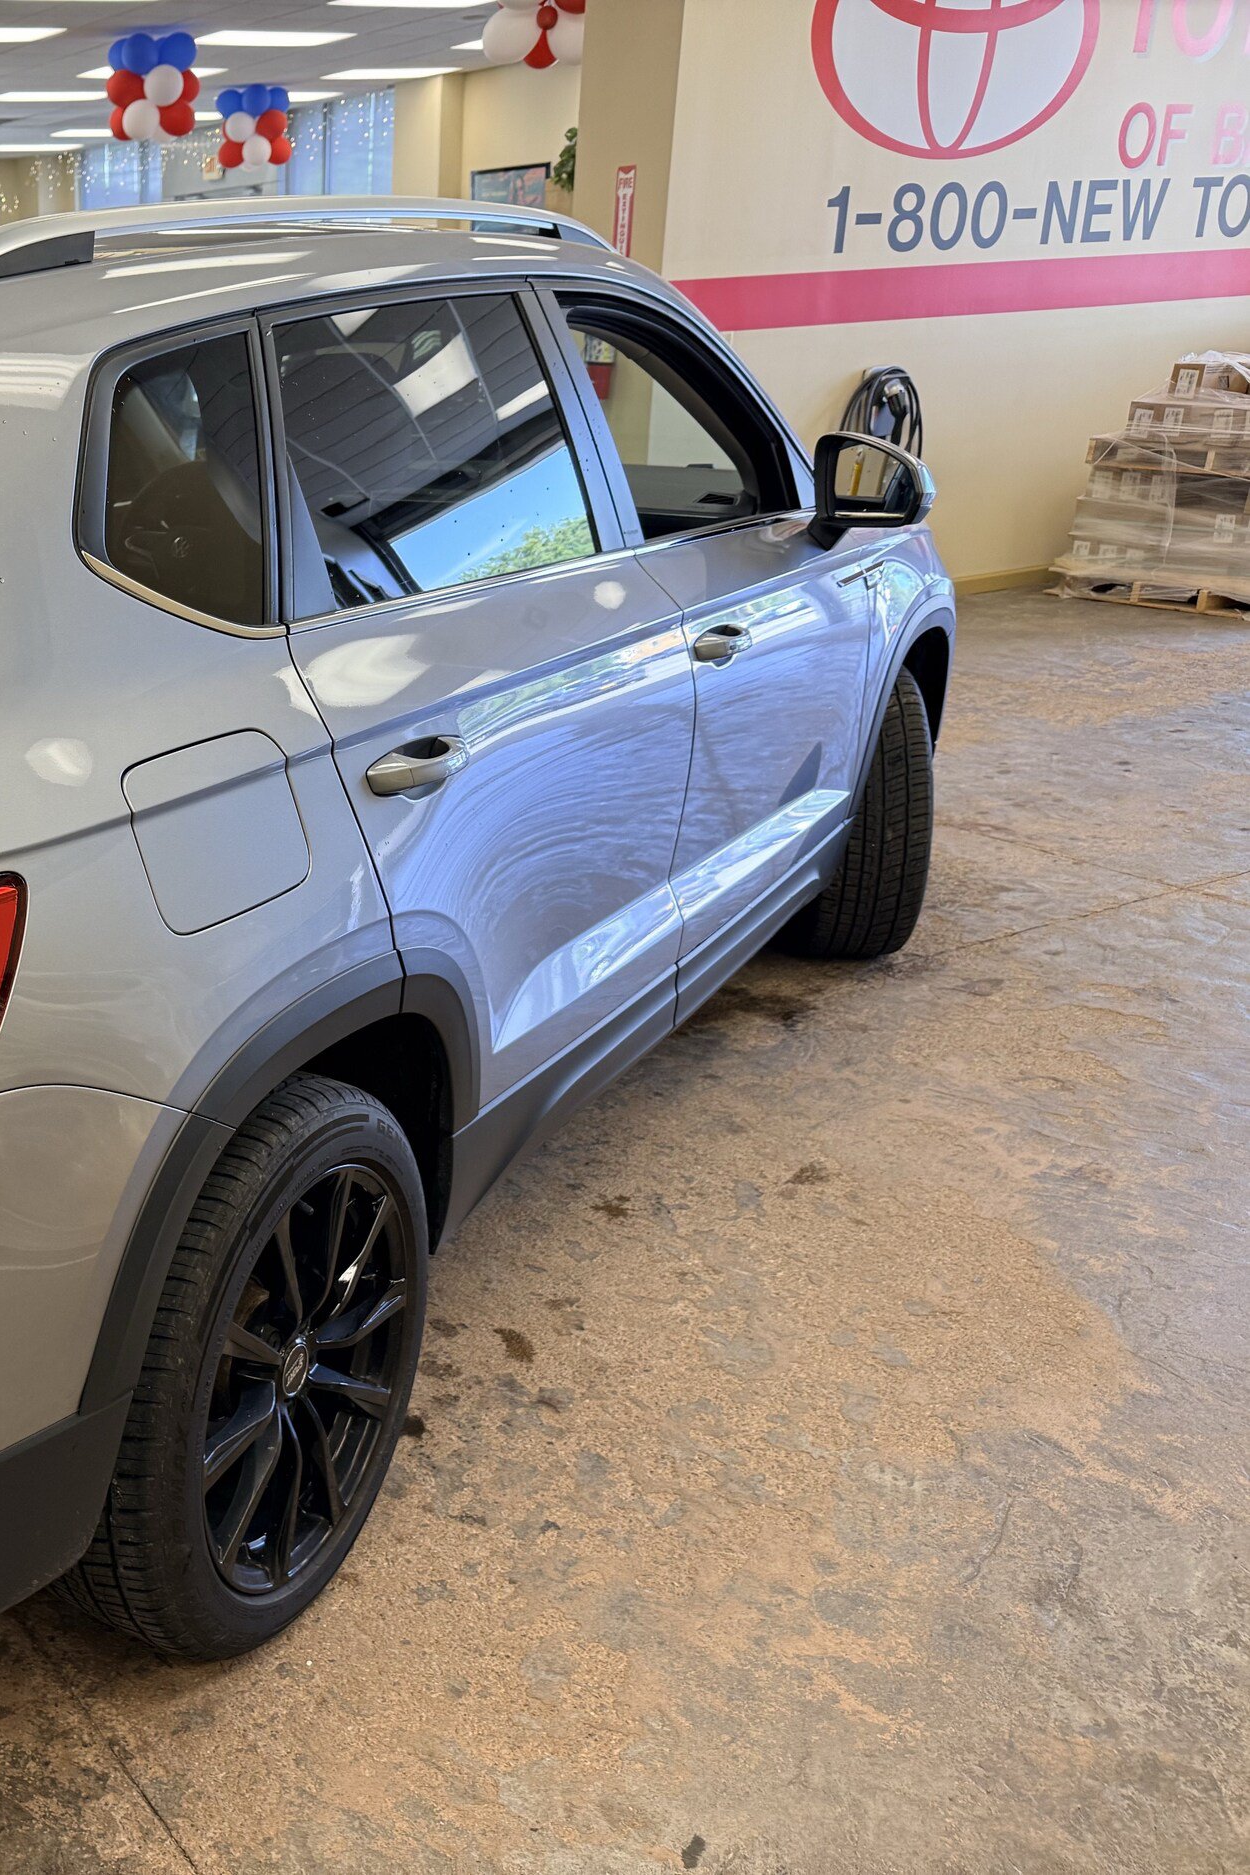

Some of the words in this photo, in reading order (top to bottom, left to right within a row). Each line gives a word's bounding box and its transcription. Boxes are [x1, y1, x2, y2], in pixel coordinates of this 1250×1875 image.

[1118, 102, 1194, 169] OF
[1210, 102, 1250, 168] B
[618, 176, 634, 189] FIRE
[827, 178, 1171, 254] 1-800-NEW
